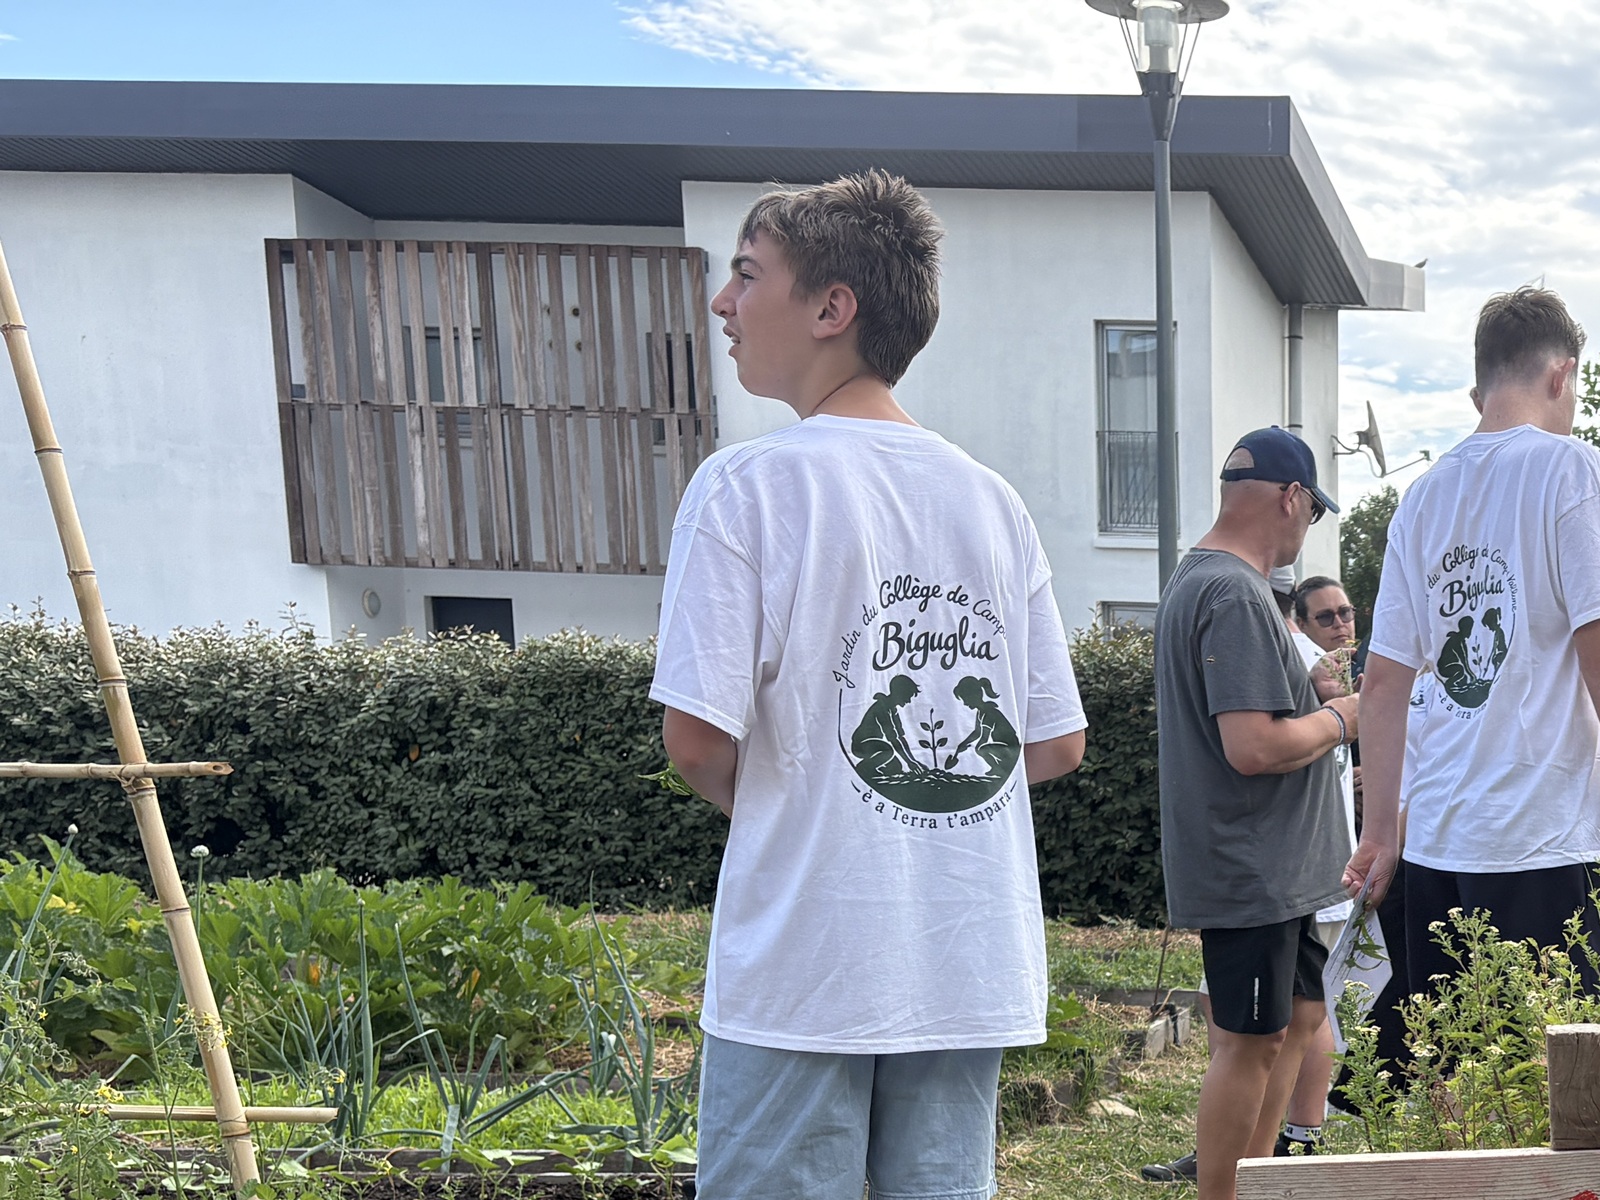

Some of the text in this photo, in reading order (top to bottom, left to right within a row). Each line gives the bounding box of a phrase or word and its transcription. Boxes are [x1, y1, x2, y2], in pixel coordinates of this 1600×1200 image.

[1427, 573, 1441, 590] du
[1481, 543, 1489, 558] d
[1439, 564, 1505, 618] Bigulia
[832, 629, 861, 689] Jardin
[862, 604, 879, 626] du
[879, 574, 943, 612] Collège
[946, 585, 970, 607] de
[872, 615, 999, 671] Biguglia
[1446, 703, 1454, 712] a
[875, 801, 885, 814] a
[892, 804, 938, 829] Terra
